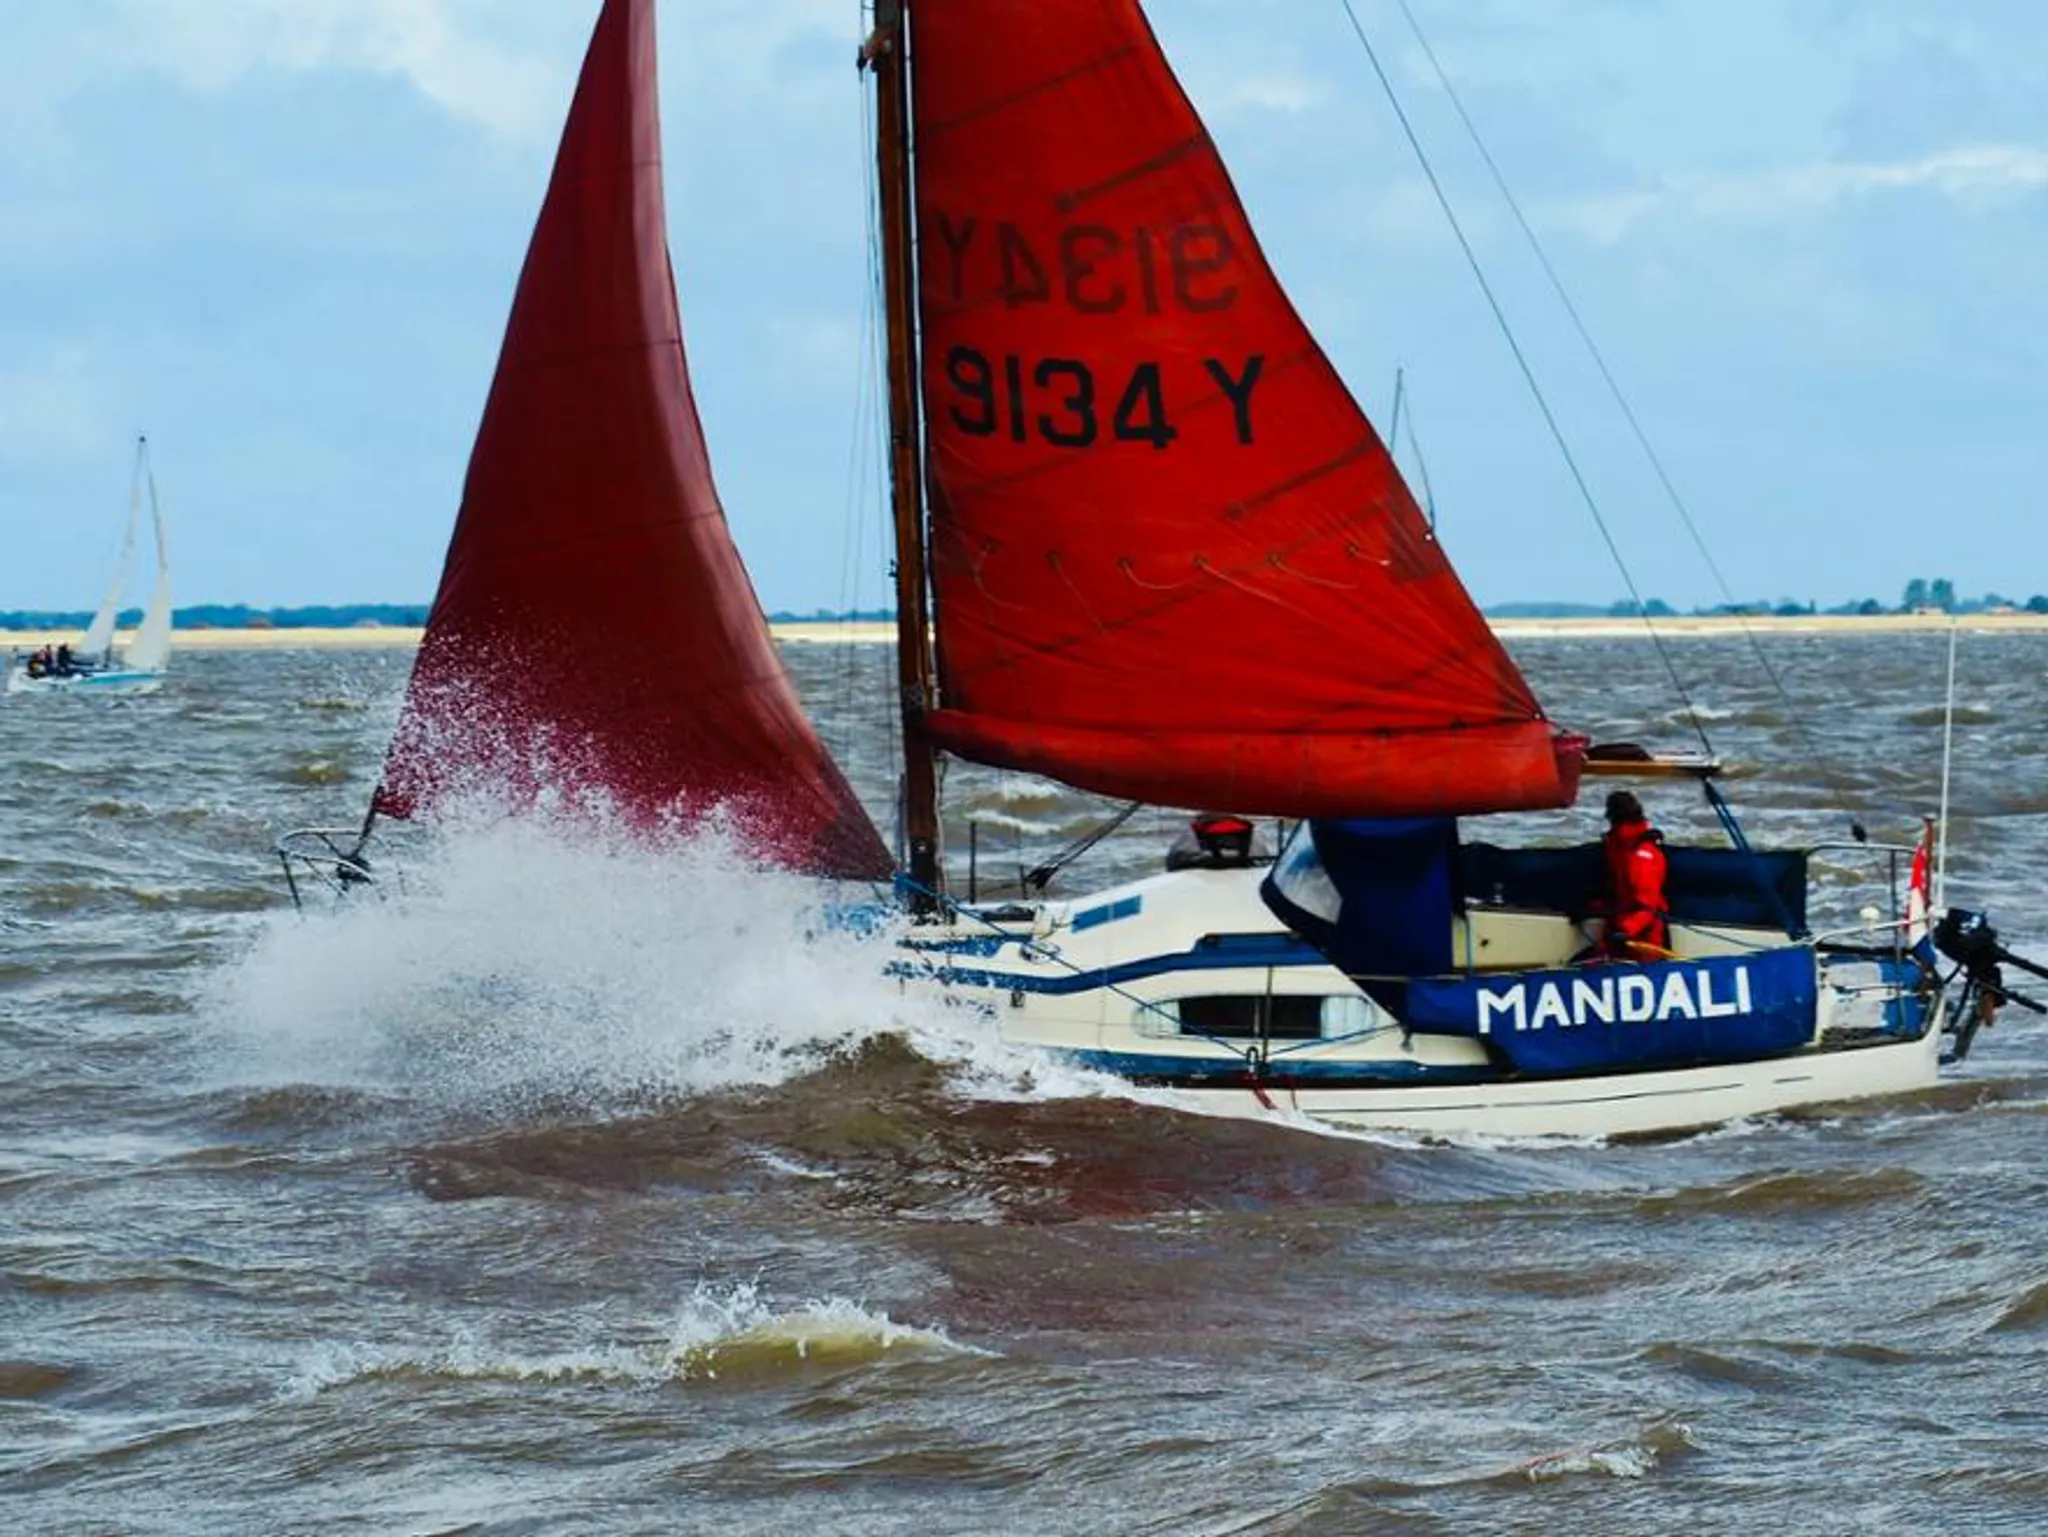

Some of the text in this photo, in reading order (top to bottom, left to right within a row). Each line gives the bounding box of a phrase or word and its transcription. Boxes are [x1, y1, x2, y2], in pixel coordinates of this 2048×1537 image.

[946, 346, 1265, 449] 9134 Y
[1477, 966, 1752, 1034] MANDALI
